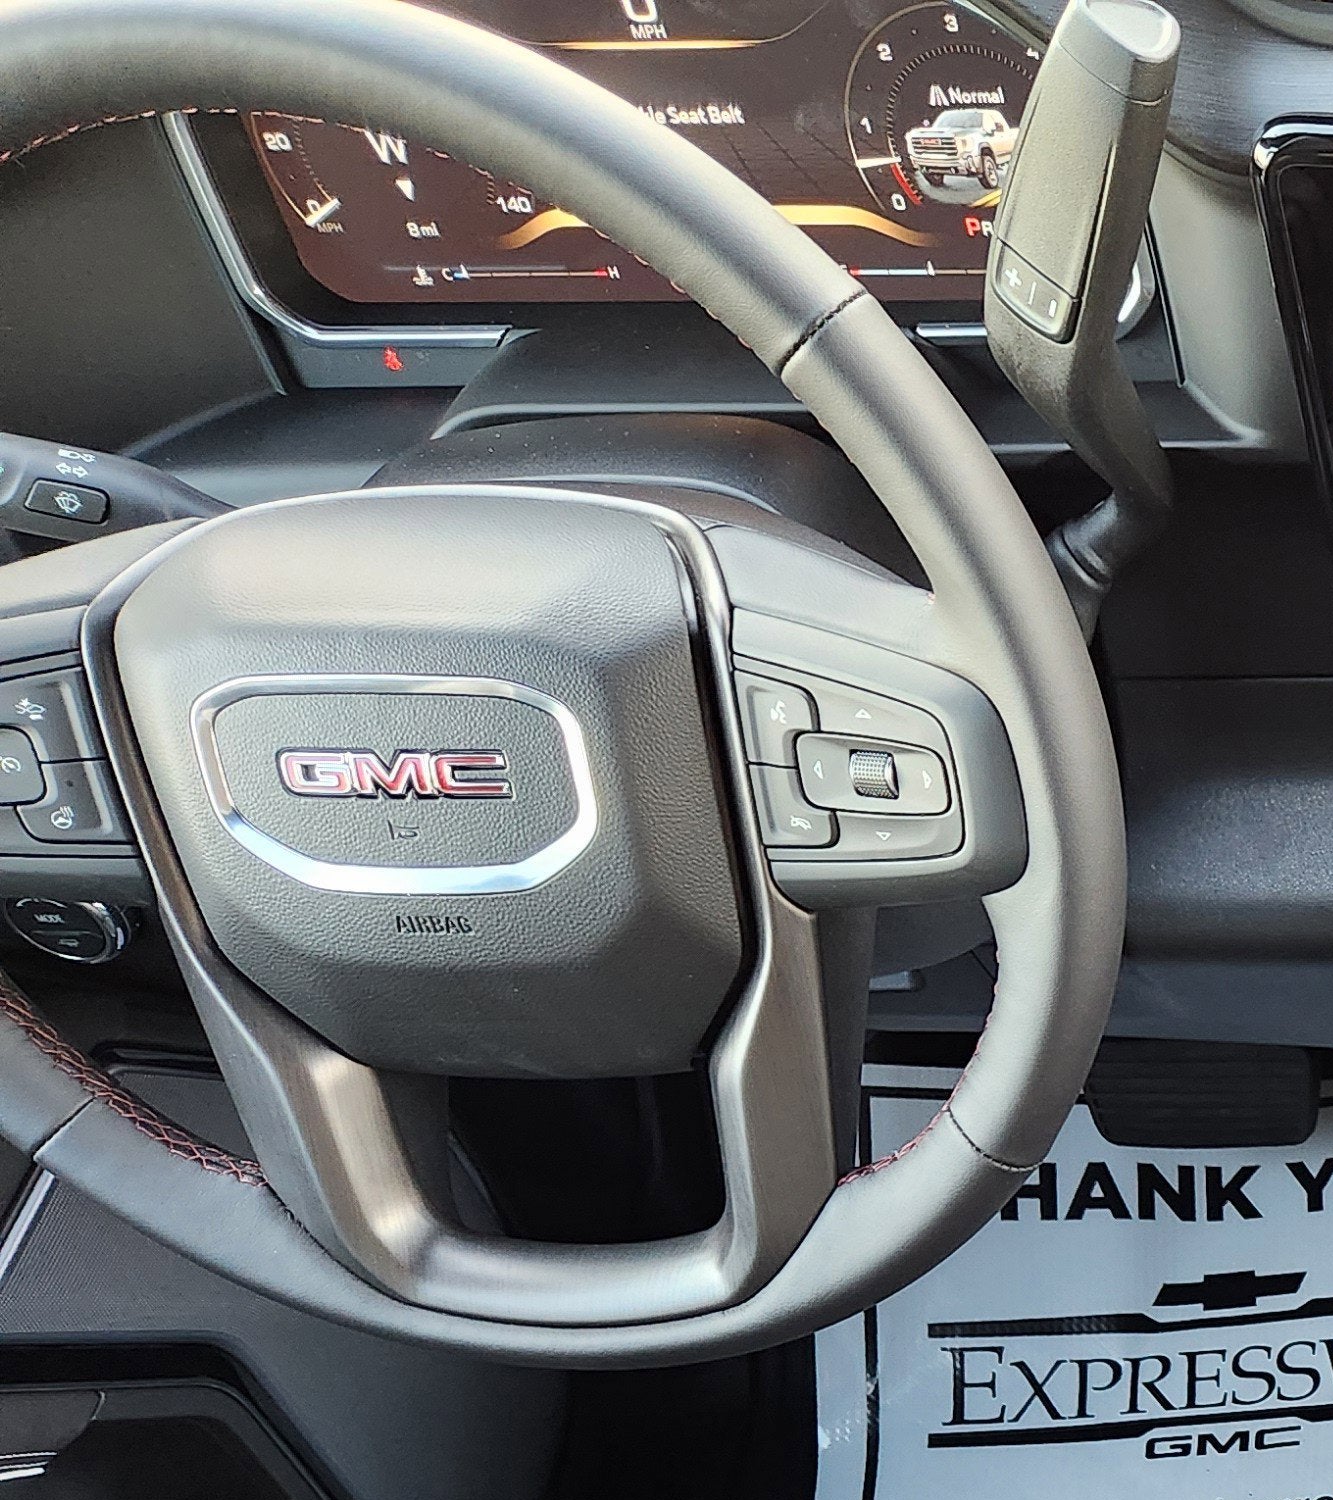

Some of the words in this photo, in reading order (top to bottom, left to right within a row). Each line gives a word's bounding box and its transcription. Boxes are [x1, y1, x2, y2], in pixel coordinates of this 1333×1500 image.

[629, 24, 668, 39] MPH
[943, 13, 960, 32] 3
[876, 43, 893, 62] 2
[948, 86, 1005, 104] Normal
[668, 106, 708, 125] Seat
[707, 103, 745, 125] Belt
[860, 117, 873, 135] 1
[263, 132, 292, 151] 20
[497, 196, 533, 213] 140
[890, 193, 906, 211] 0
[317, 222, 344, 234] MPH
[608, 265, 620, 279] H
[275, 747, 516, 800] GMC
[396, 915, 474, 935] AIRBAG
[1000, 1161, 1263, 1221] HANK
[1145, 1426, 1301, 1459] GMC
